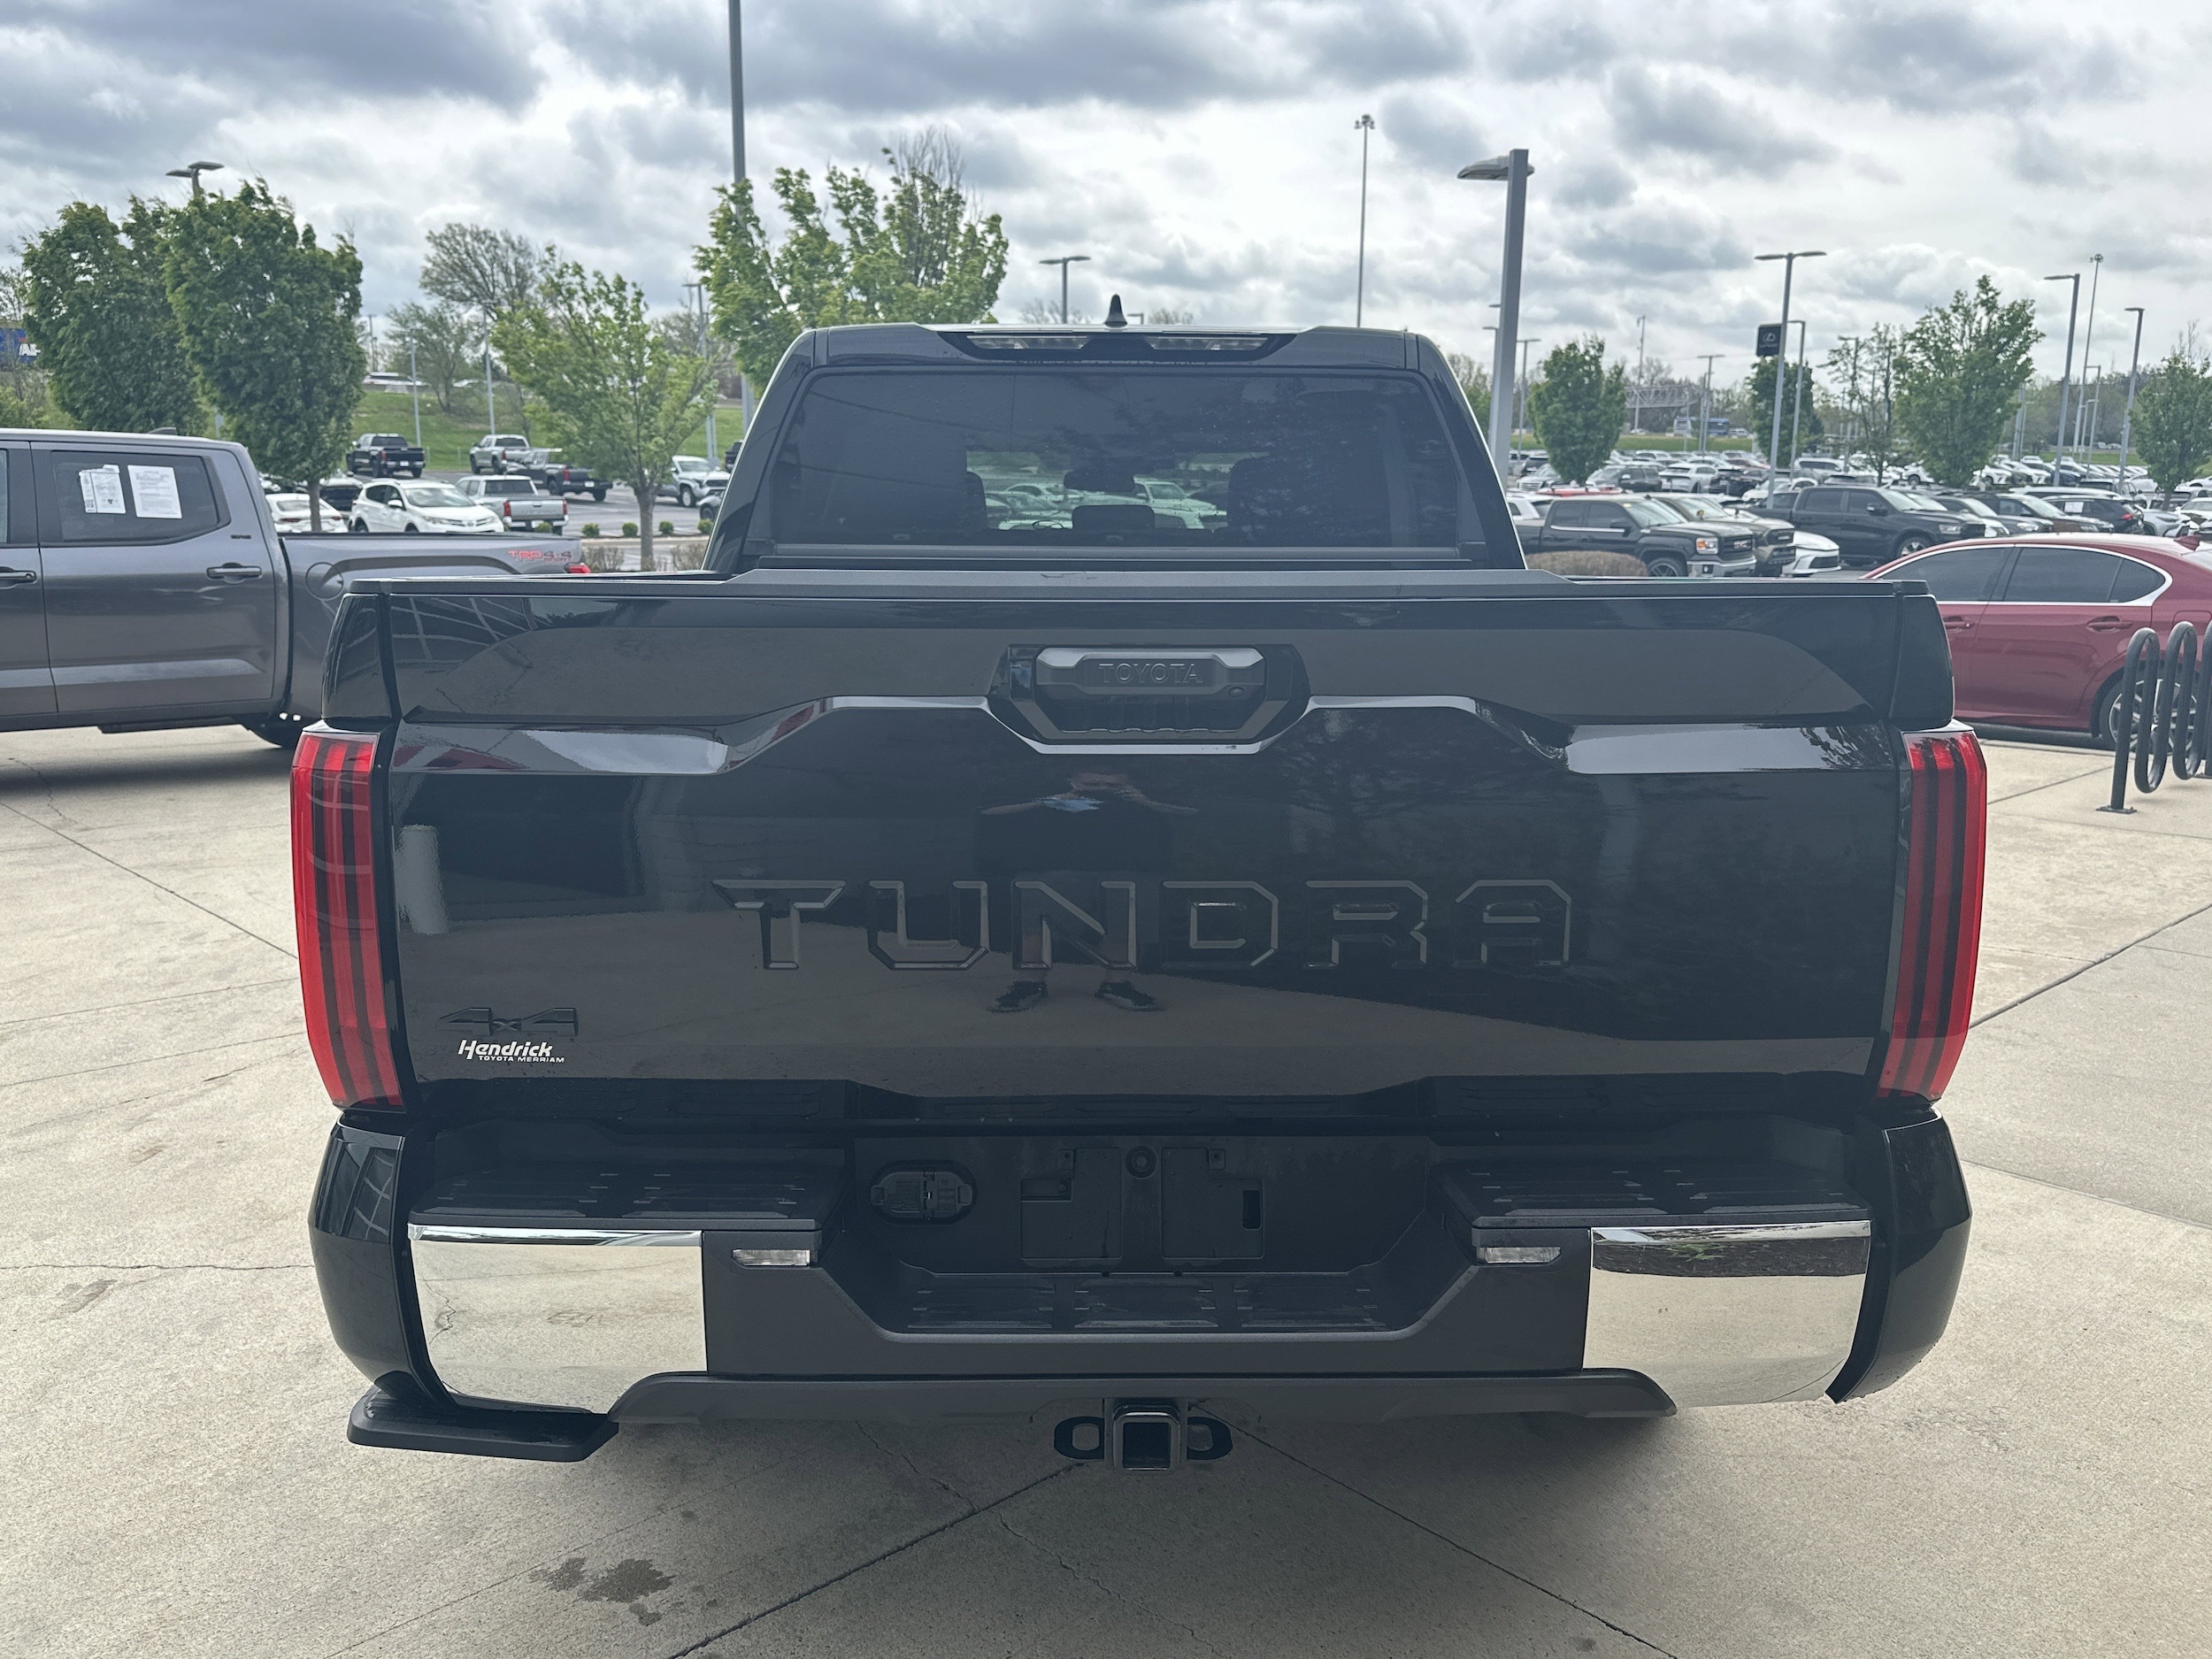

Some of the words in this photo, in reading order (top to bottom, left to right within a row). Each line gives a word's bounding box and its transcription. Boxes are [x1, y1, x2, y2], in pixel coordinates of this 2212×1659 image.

[508, 550, 542, 560] TRD
[1098, 663, 1203, 684] TOYOTA
[710, 879, 1573, 970] TUNDRA
[457, 1039, 553, 1060] Hendrick
